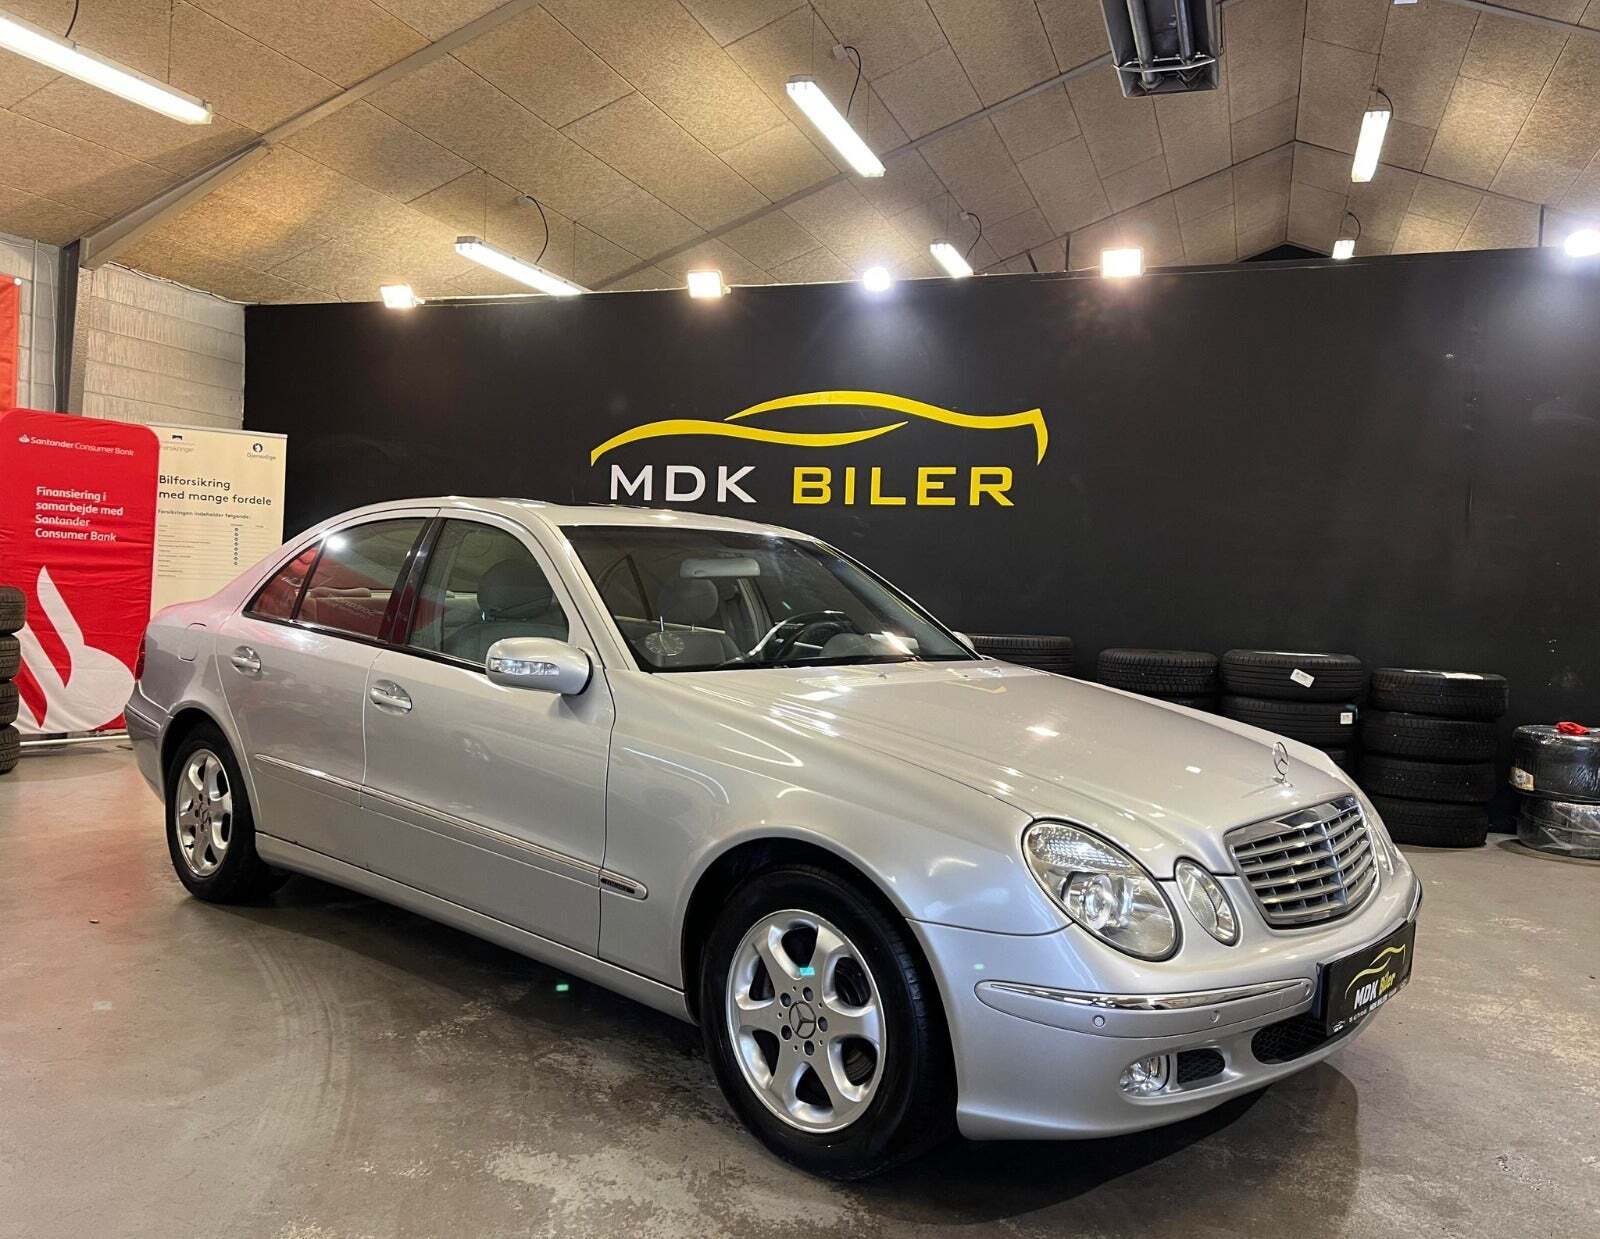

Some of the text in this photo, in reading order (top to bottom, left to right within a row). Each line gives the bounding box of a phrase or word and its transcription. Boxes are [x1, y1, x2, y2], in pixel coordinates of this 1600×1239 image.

[30, 436, 135, 457] Santander Consumer Bank
[159, 475, 231, 491] Bilforsikring
[609, 464, 1014, 506] MDK BILER
[36, 486, 107, 503] Finansiering i
[159, 490, 272, 506] med mange fordele
[35, 502, 124, 517] samarbejde med
[35, 514, 91, 527] Santander
[35, 528, 117, 542] Consumer Bank
[1353, 979, 1379, 1010] MDK
